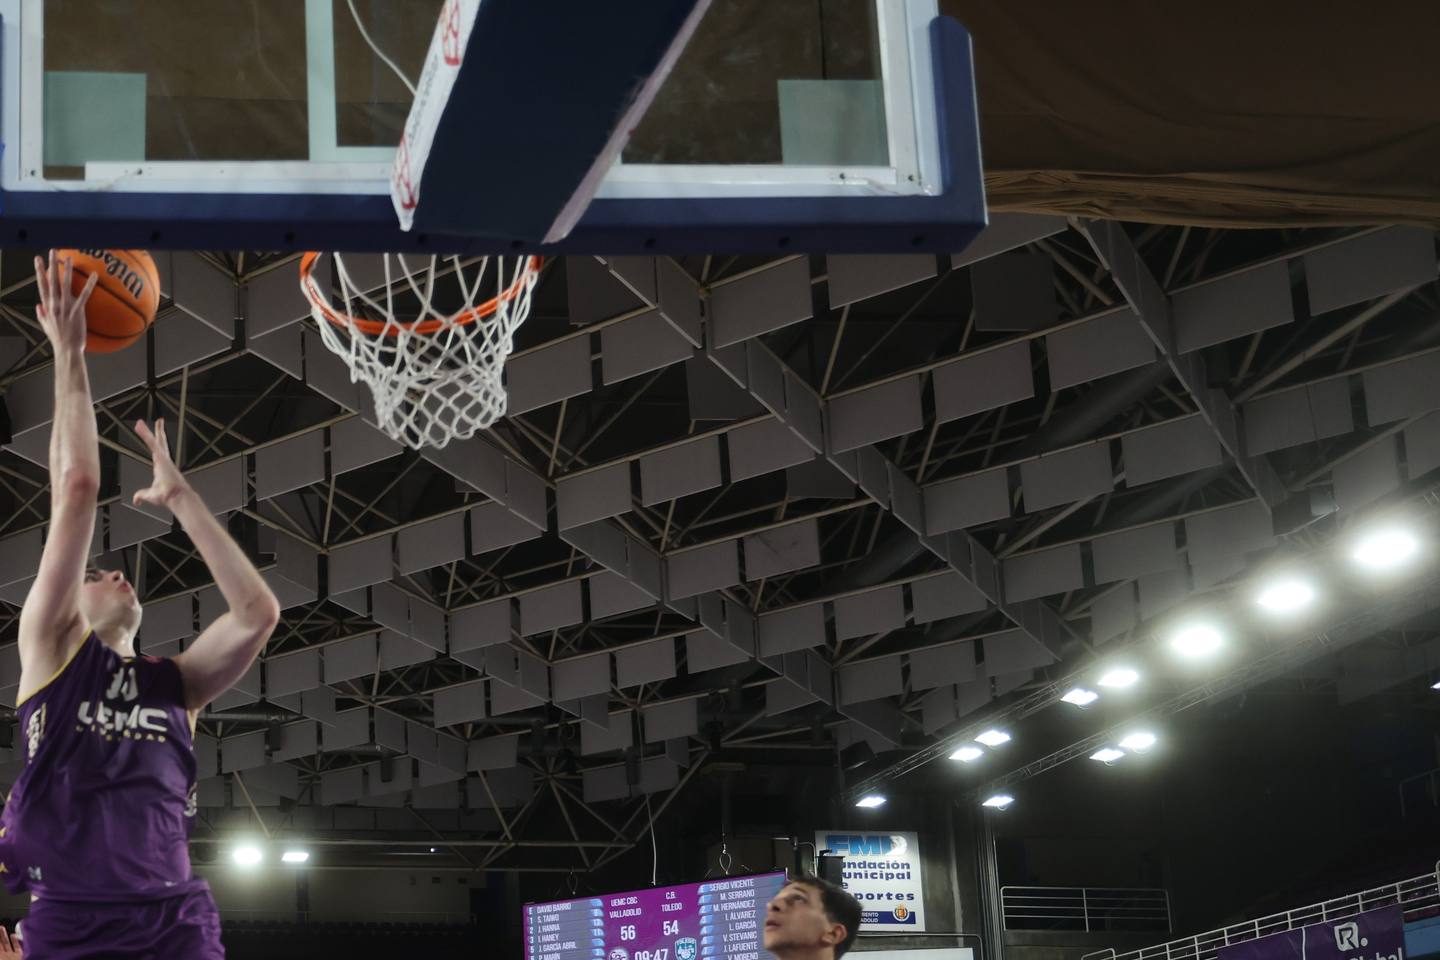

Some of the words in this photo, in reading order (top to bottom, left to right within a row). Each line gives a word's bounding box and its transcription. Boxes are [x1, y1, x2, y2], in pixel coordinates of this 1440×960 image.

[842, 860, 911, 870] undación
[842, 871, 911, 881] unicipal
[730, 879, 754, 888] VICENTE
[728, 890, 755, 899] SERRANO
[854, 892, 915, 901] portes
[662, 902, 683, 912] TOLEDO
[620, 925, 636, 941] 56
[663, 920, 679, 936] 54
[729, 931, 757, 942] STEVANIC
[729, 941, 758, 952] LAFUENTE
